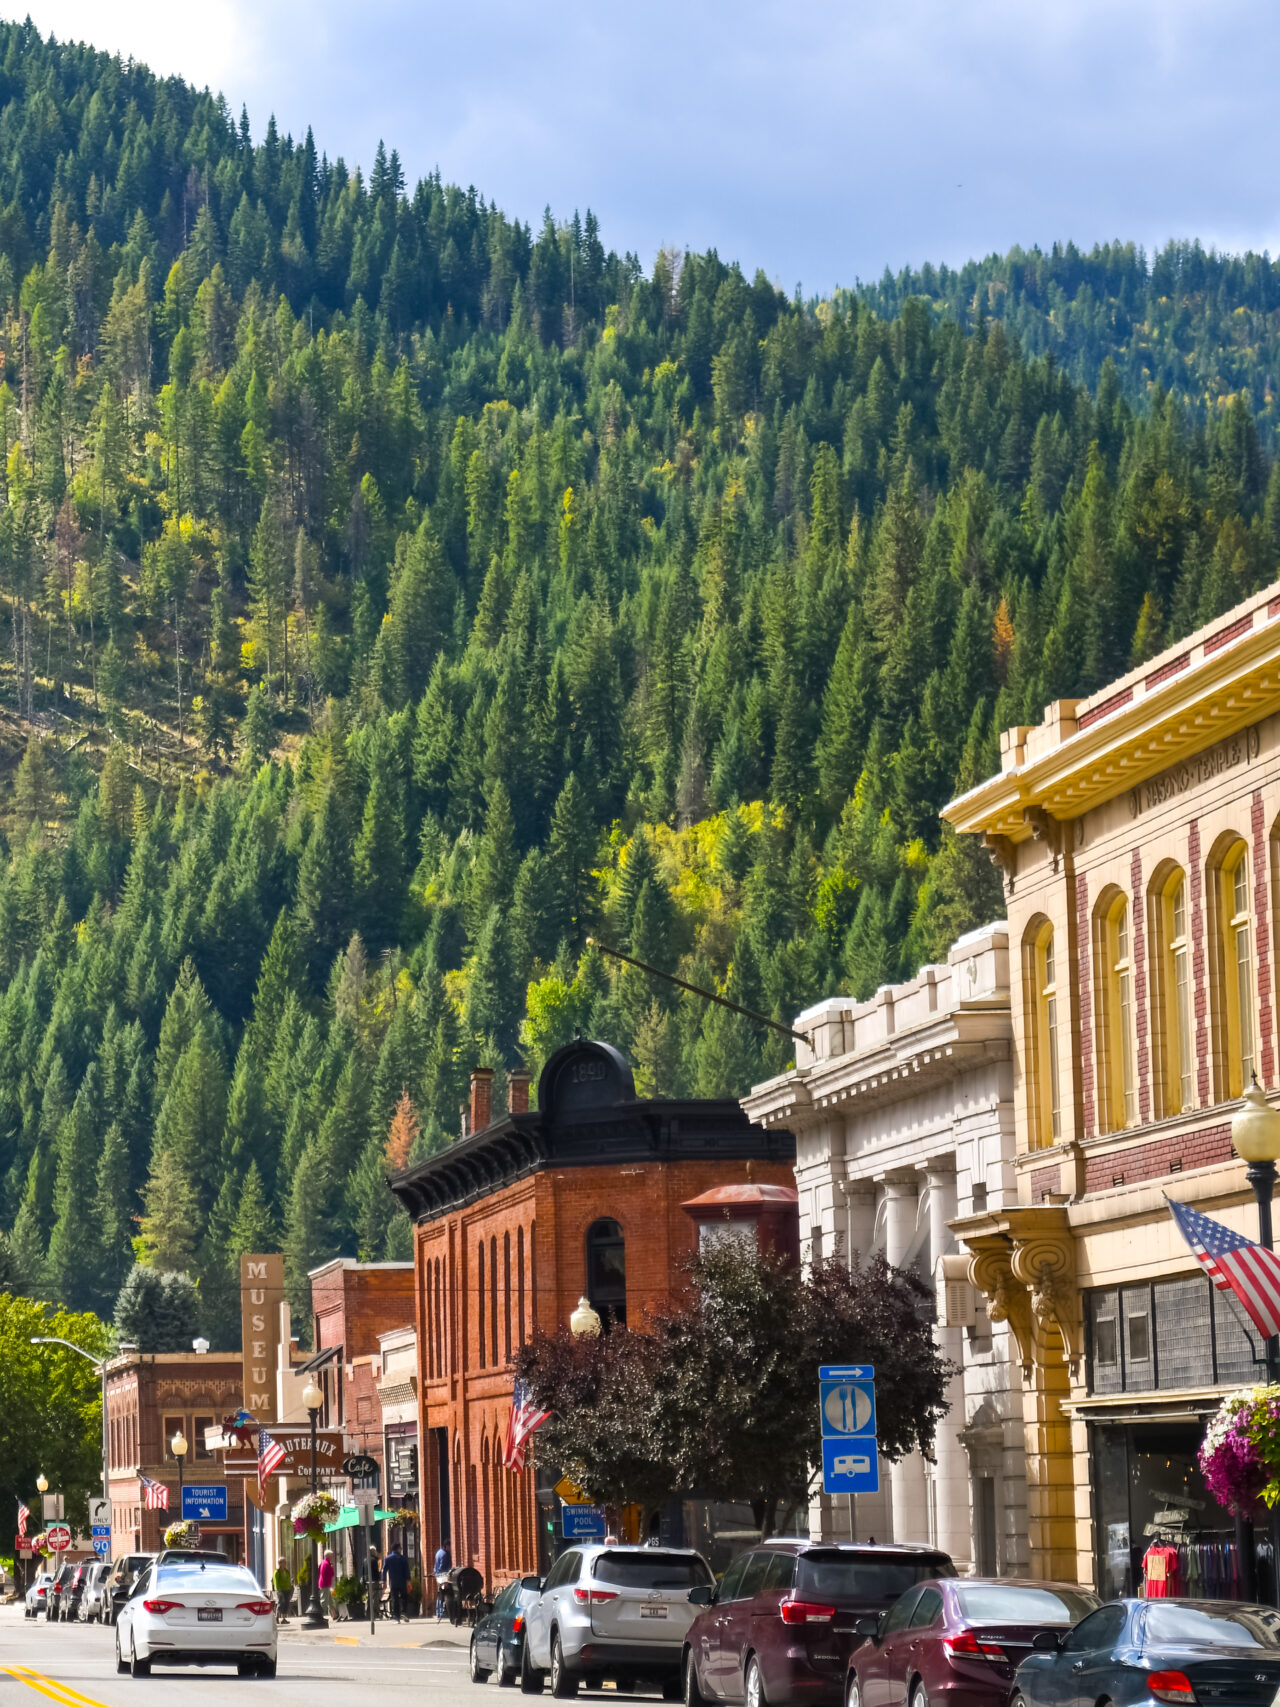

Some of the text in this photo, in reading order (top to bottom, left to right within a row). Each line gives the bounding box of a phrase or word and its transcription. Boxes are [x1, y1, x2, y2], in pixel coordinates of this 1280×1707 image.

[1194, 744, 1241, 784] TEMPLE
[246, 1262, 270, 1411] MUSEUM
[191, 1488, 217, 1497] TOURIST
[185, 1497, 224, 1505] INFORMATION
[574, 1517, 593, 1525] POOL
[93, 1541, 109, 1551] 90
